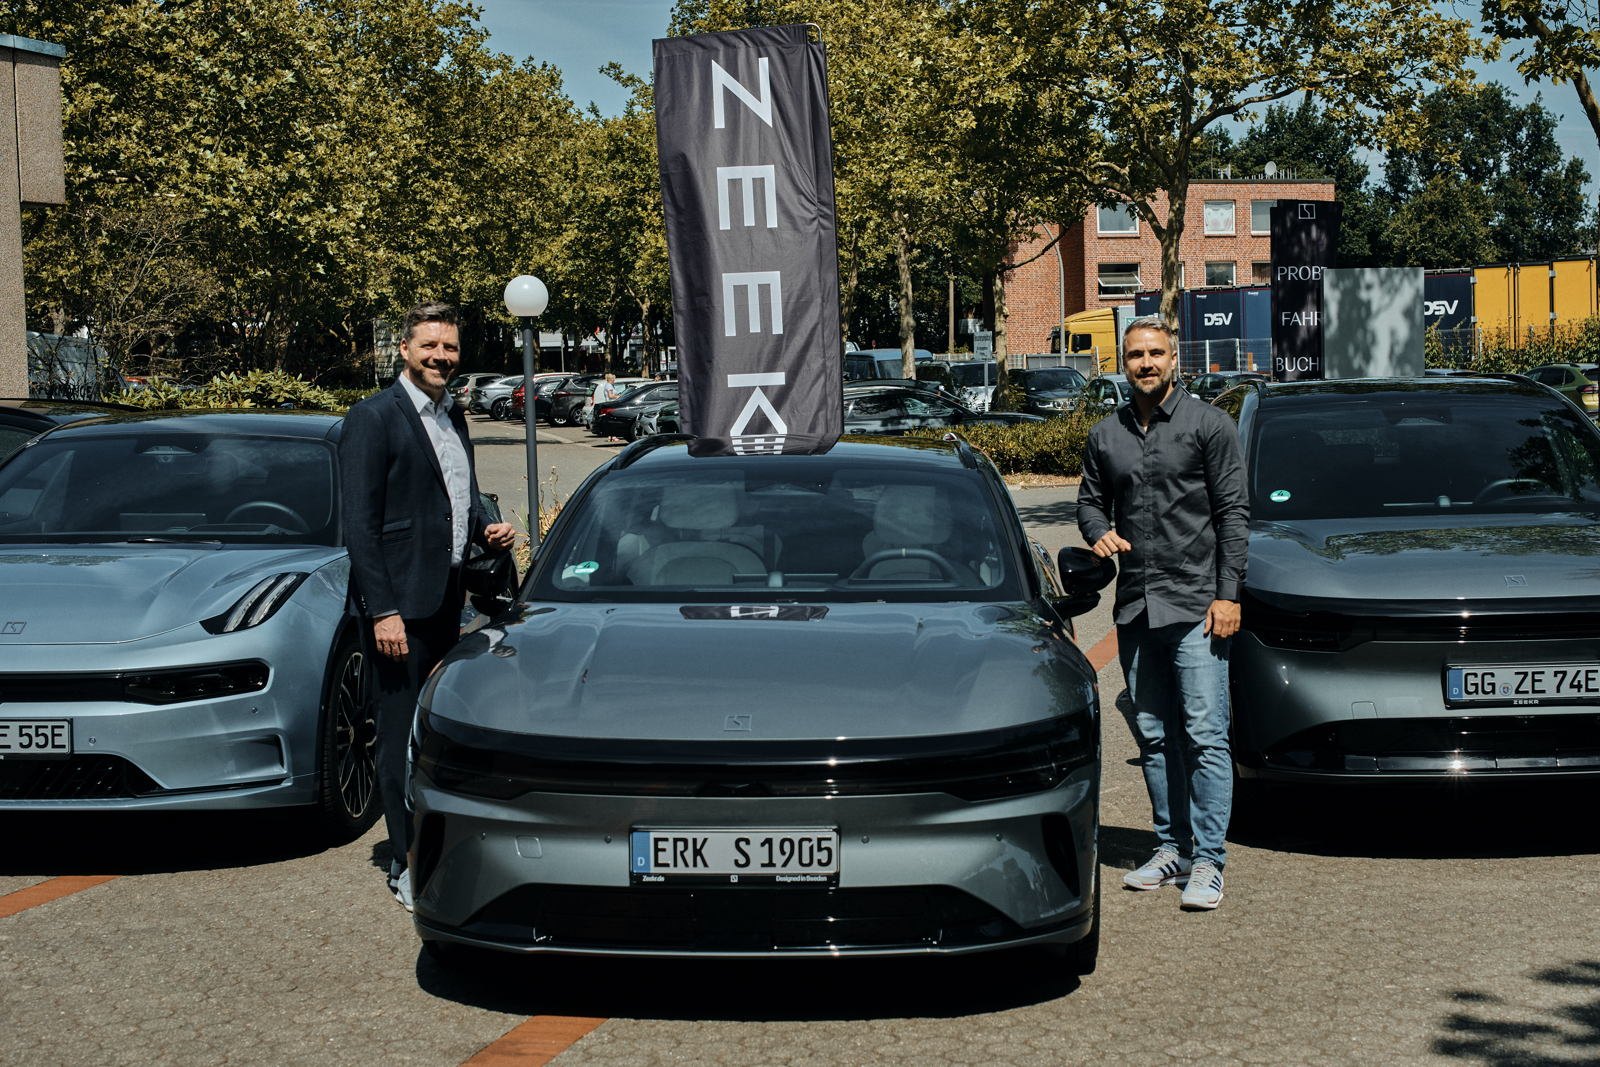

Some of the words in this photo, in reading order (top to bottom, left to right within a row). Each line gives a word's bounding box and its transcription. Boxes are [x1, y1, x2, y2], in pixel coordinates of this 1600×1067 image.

[1277, 265, 1327, 281] PROB
[1204, 312, 1233, 327] DSV
[1464, 672, 1496, 695] GG
[1514, 671, 1546, 694] ZE
[1553, 669, 1600, 693] 74E
[1453, 687, 1459, 695] D
[18, 725, 66, 749] 55E
[653, 837, 709, 868] ERK
[734, 837, 751, 868] S
[760, 837, 833, 868] 1905
[637, 857, 645, 866] D
